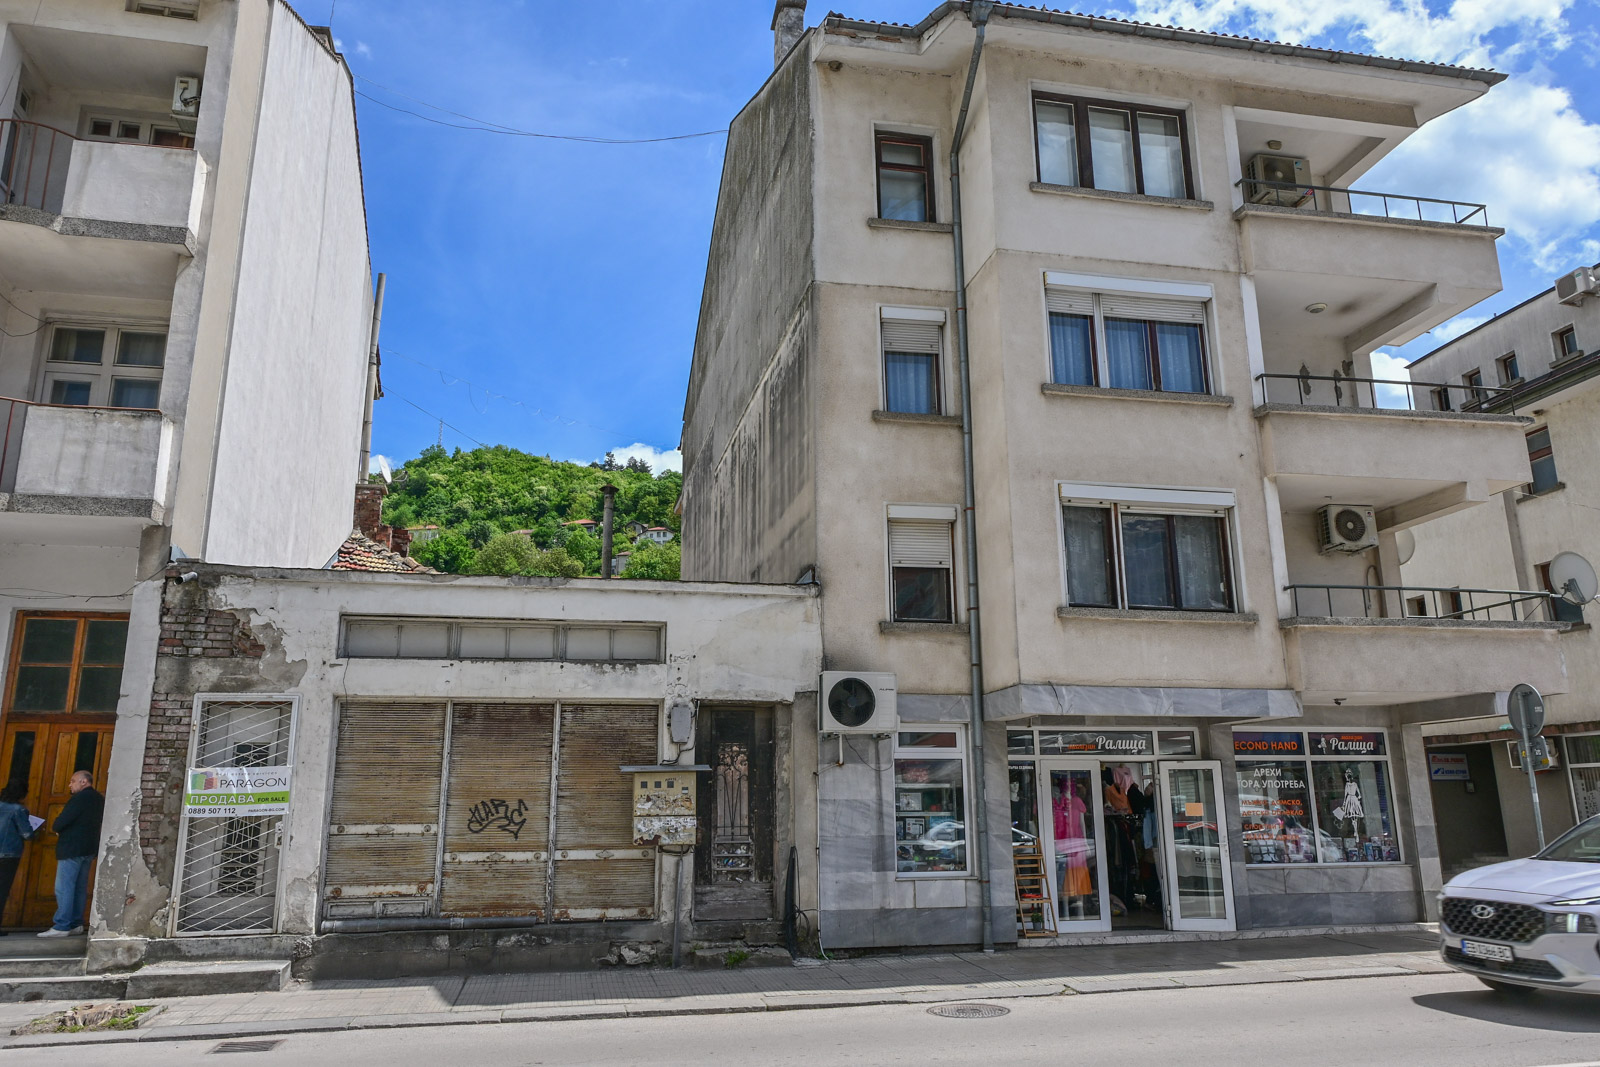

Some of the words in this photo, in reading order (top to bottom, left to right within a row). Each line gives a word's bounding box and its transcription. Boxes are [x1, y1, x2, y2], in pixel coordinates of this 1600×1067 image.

[1096, 735, 1146, 754] Ралица
[1234, 741, 1269, 750] ECOND
[1270, 741, 1298, 750] HAND
[1330, 737, 1374, 753] Ралица
[1253, 768, 1282, 777] ДРЕХИ
[220, 777, 287, 788] PARAGON
[1261, 780, 1306, 789] УПОТРЕБА
[190, 795, 255, 806] ПРОДАВА
[188, 807, 207, 815] 0889
[207, 807, 222, 815] 507
